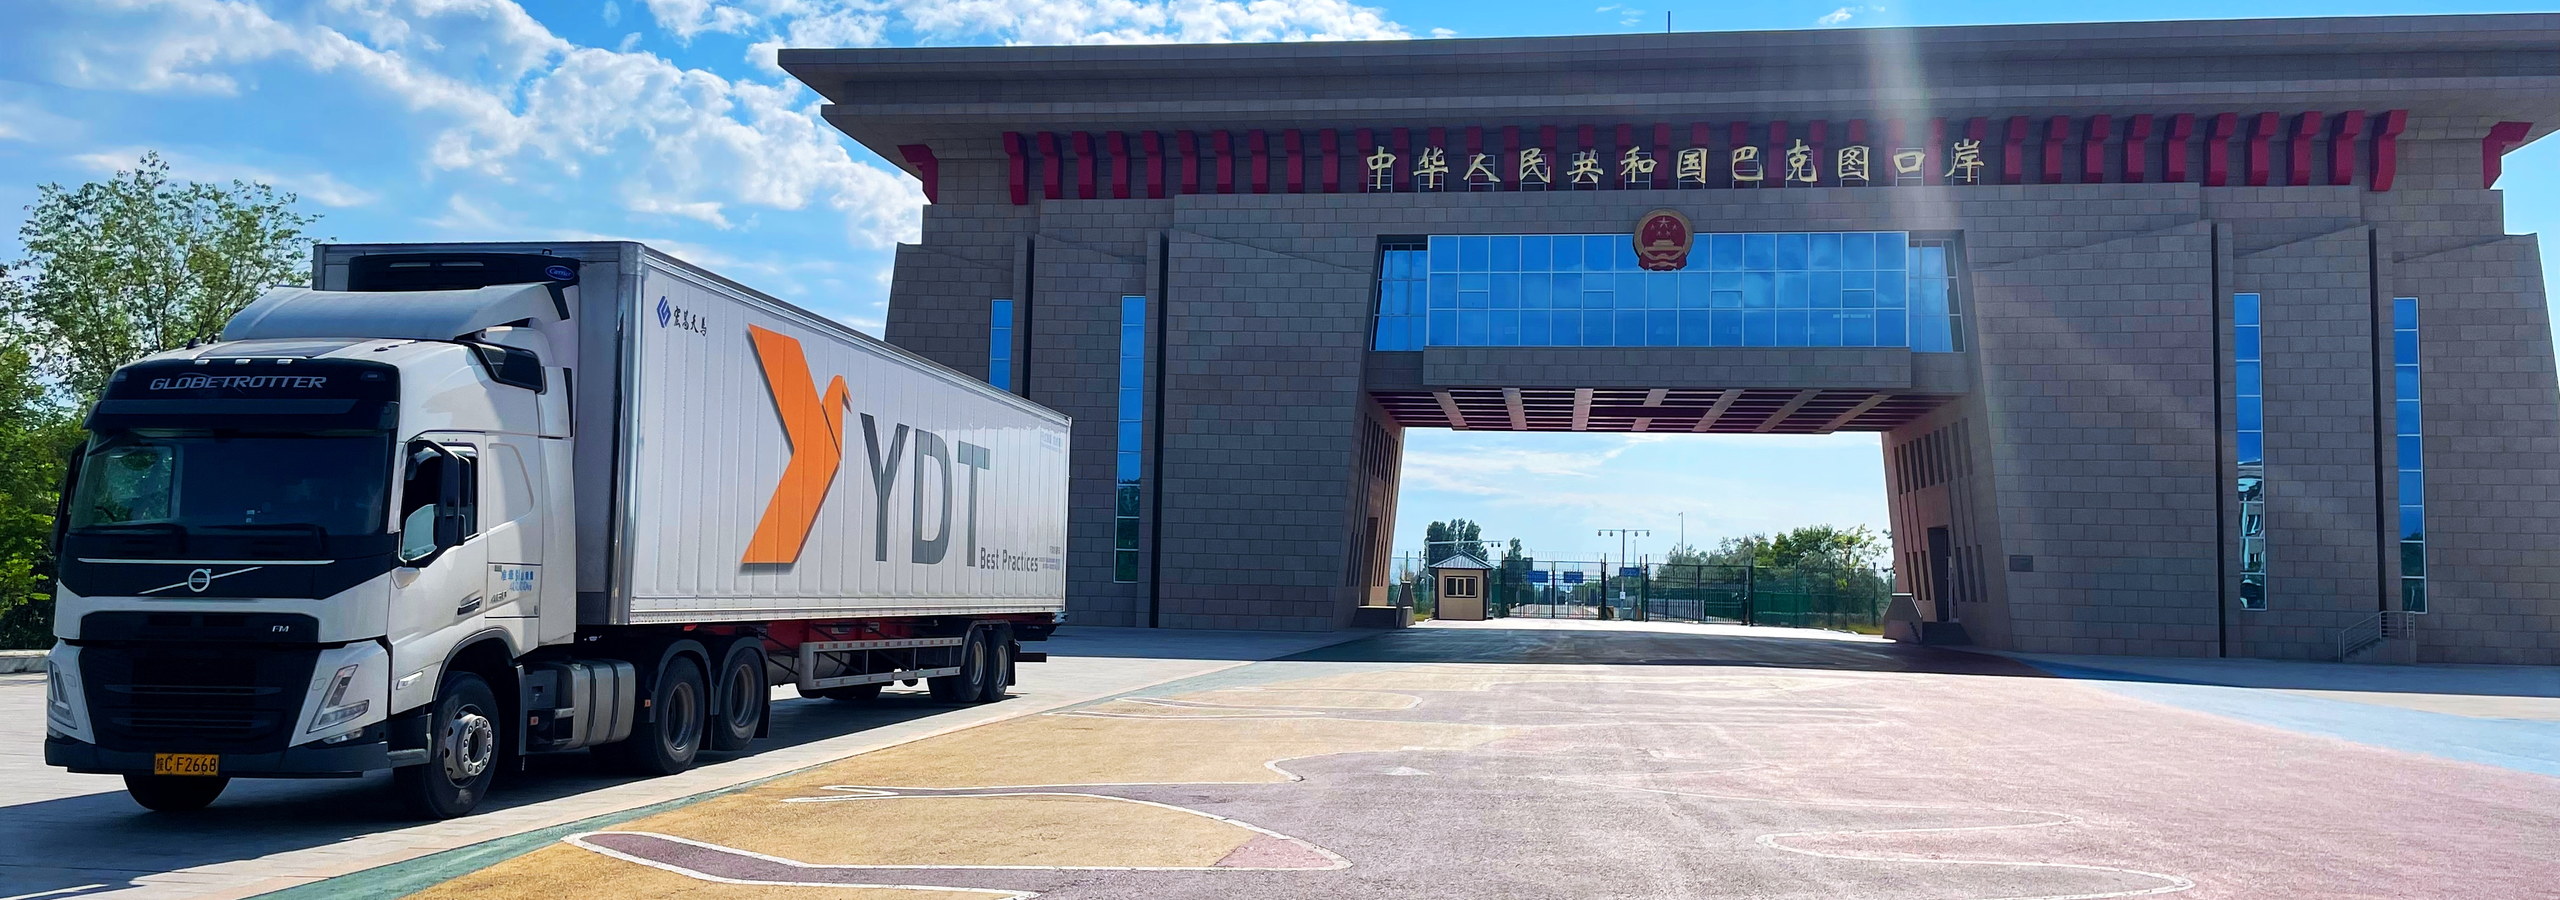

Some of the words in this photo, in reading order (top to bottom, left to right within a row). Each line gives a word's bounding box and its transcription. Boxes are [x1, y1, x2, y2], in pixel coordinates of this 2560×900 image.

[1366, 138, 1985, 190] 中华人民共和国巴克图口岸
[150, 375, 327, 390] GLOBETROTTER
[860, 412, 991, 567] YDT
[980, 547, 999, 570] Best
[1002, 549, 1039, 572] Practices
